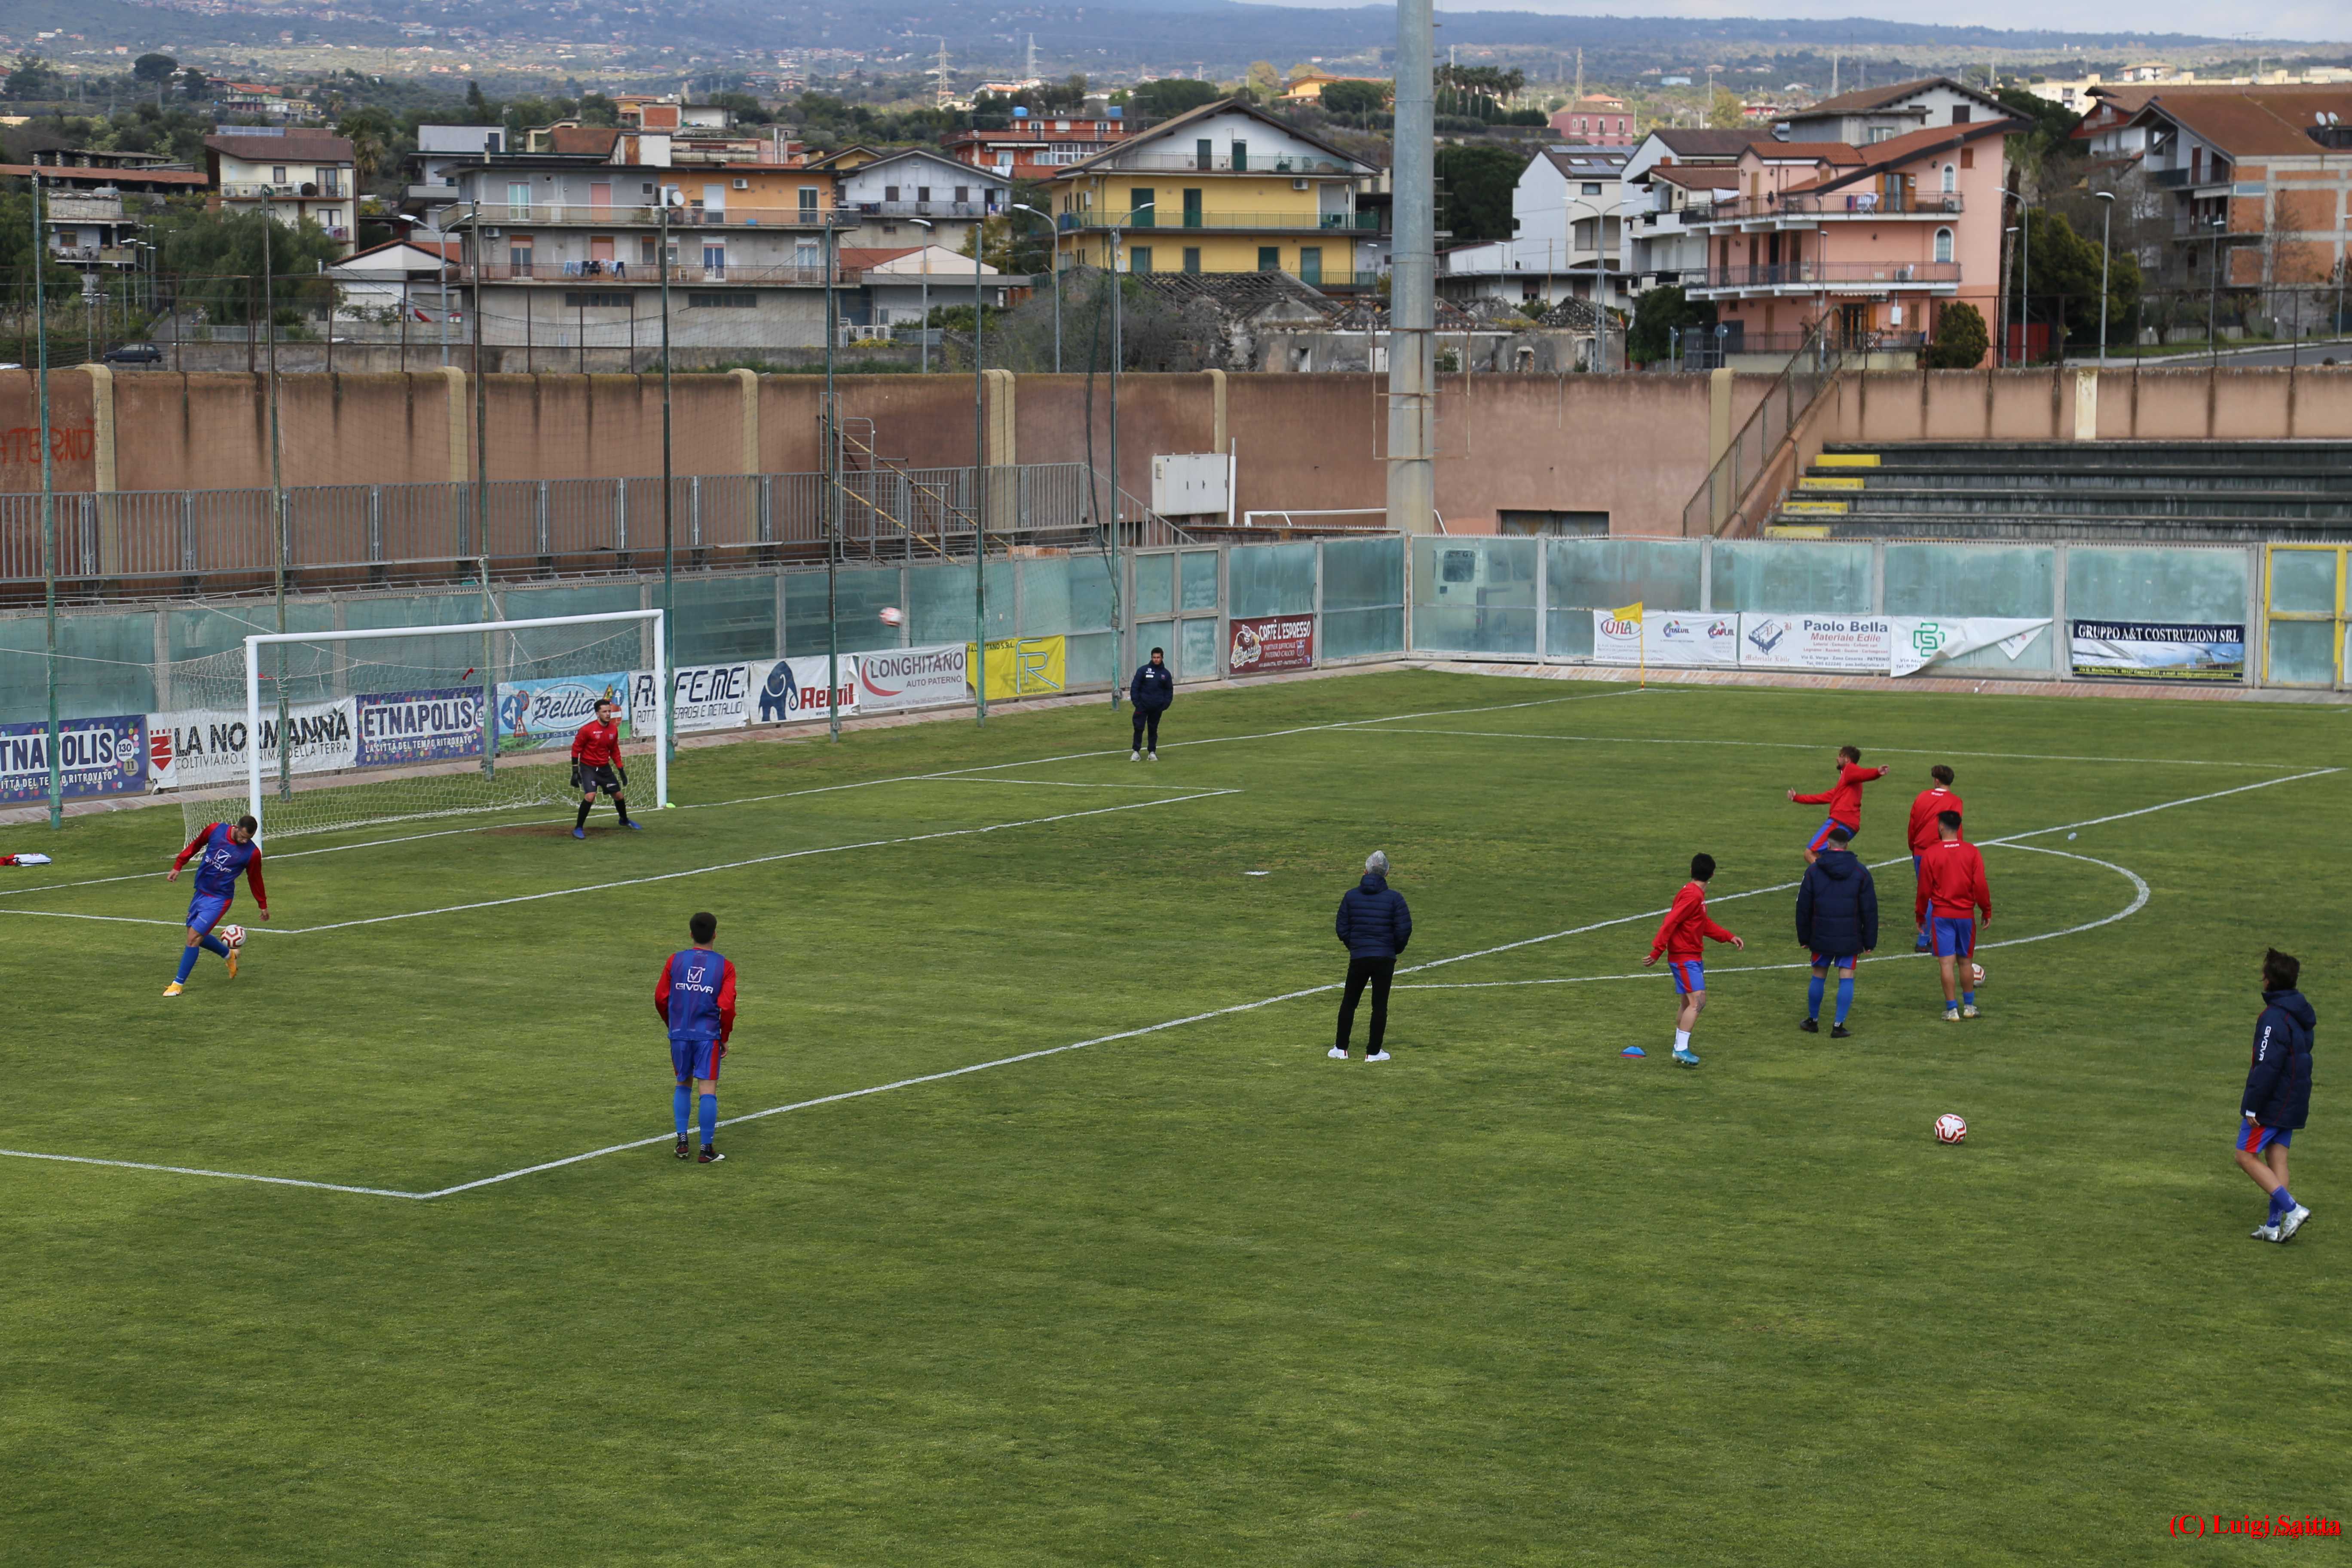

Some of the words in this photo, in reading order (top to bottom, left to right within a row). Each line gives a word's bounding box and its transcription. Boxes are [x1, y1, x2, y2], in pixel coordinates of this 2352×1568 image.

[1259, 619, 1277, 641] CAFFÈ
[1278, 621, 1311, 640] L'ESPRESSO
[1606, 621, 1632, 634] UILA
[1804, 620, 1844, 631] Paolo
[1850, 621, 1888, 633] Bella
[2079, 625, 2120, 640] GRUPPO
[2122, 627, 2143, 640] A&T
[2145, 628, 2217, 642] COSTRUZIONI
[2219, 629, 2239, 643] SRL
[1811, 632, 1854, 642] Materiale
[1857, 633, 1881, 642] Edile
[870, 652, 964, 678] LONGHITANO
[928, 675, 962, 686] PATERNÒ
[364, 701, 473, 737] ETNAPOLIS
[701, 705, 706, 717] E
[118, 743, 132, 753] 130
[175, 726, 203, 756] LA
[365, 744, 374, 753] LA
[375, 740, 396, 752] CITTÀ
[398, 742, 411, 750] DEL
[413, 739, 435, 749] TEMPO
[437, 735, 472, 746] RITROVATO
[175, 753, 237, 770] COLTIVIAMO
[287, 744, 316, 759] DELLA
[126, 761, 135, 770] 11
[22, 778, 37, 787] DEL
[69, 771, 113, 784] RITROVATO
[676, 983, 714, 994] GIVOVA
[2259, 1026, 2272, 1061] GIVOVA
